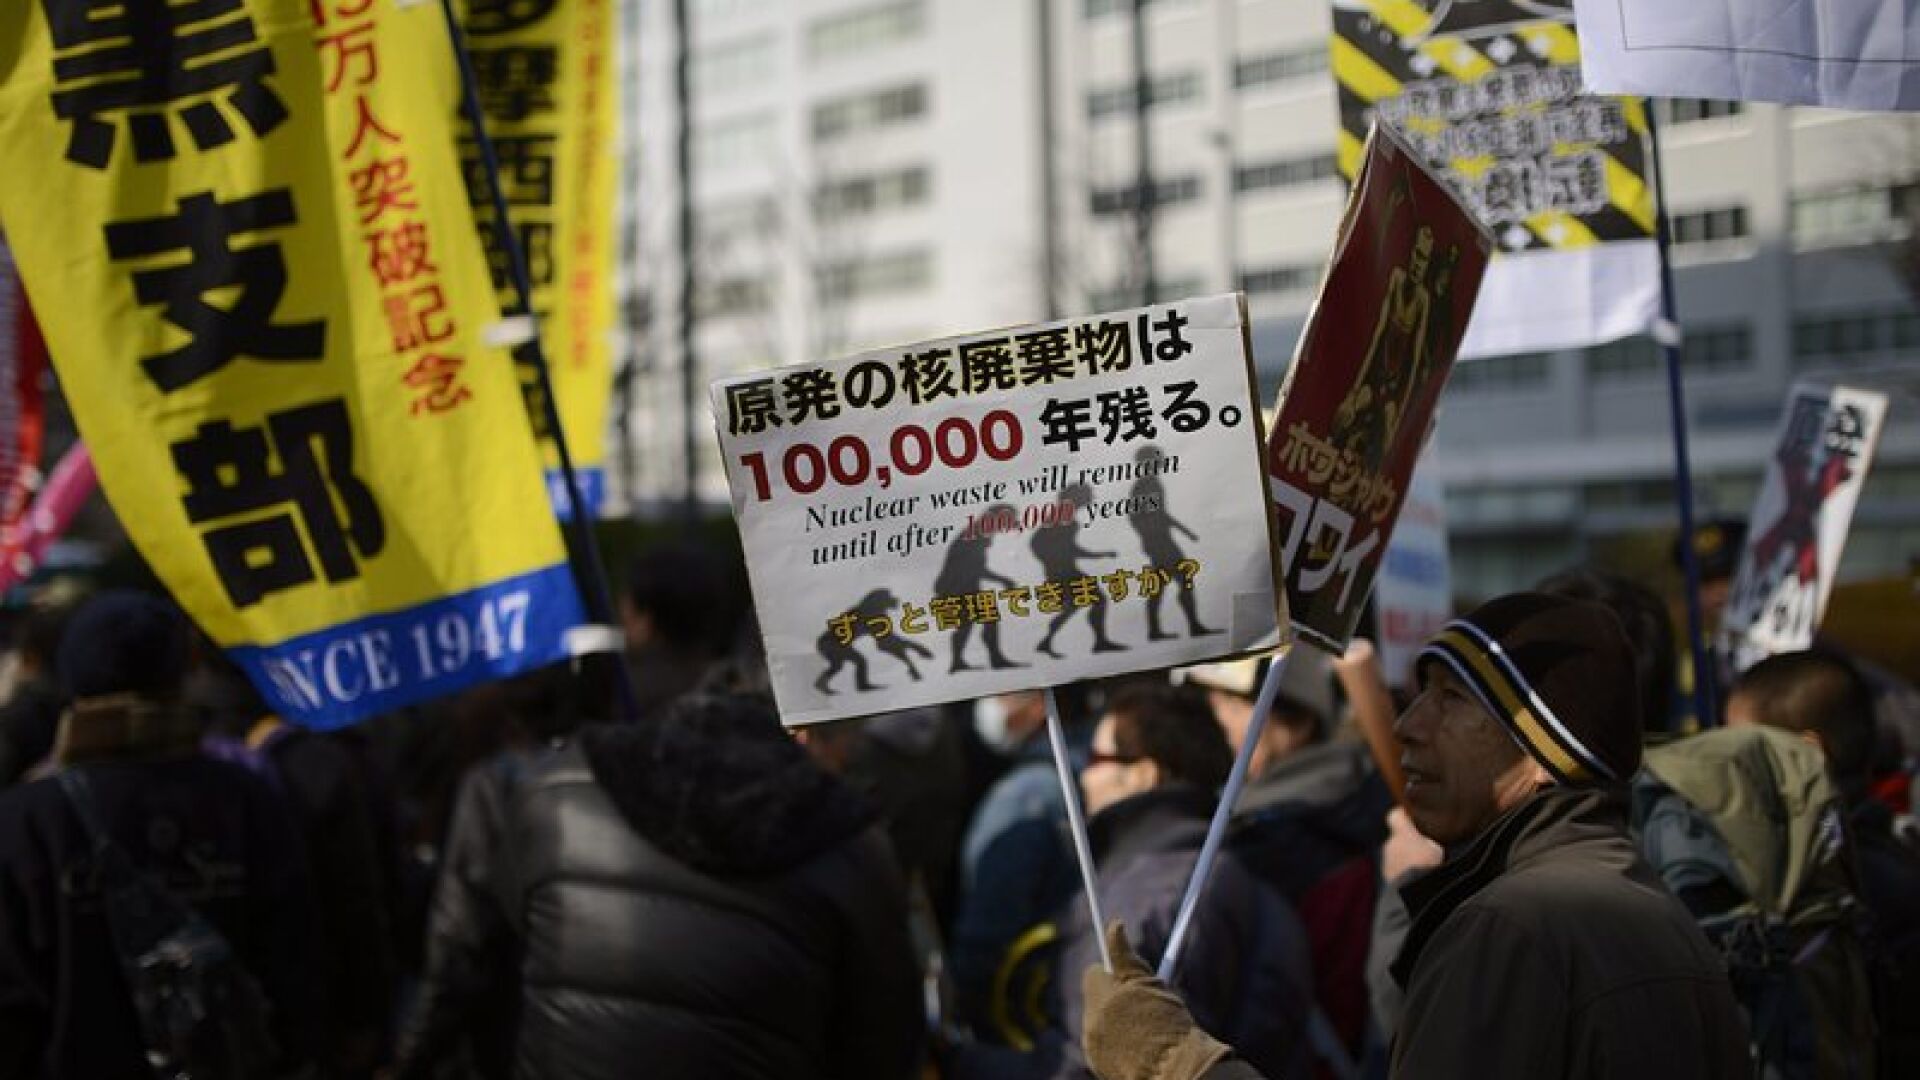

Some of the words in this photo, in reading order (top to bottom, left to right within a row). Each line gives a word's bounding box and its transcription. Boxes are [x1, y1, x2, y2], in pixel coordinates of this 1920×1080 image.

[724, 309, 1193, 437] 原発の核廃棄物は
[740, 410, 1024, 501] 100,000
[1038, 380, 1243, 453] 年残る。
[806, 496, 921, 533] Nuclear
[930, 481, 1008, 510] waste
[1018, 463, 1069, 496] will
[1079, 449, 1180, 487] remain
[812, 529, 877, 565] until
[887, 522, 954, 557] after
[962, 501, 1076, 543] 100,000
[1084, 495, 1163, 529] years
[262, 629, 401, 711] NCE
[411, 590, 531, 679] 1947
[827, 560, 1202, 645] ずっと管理できますか？
